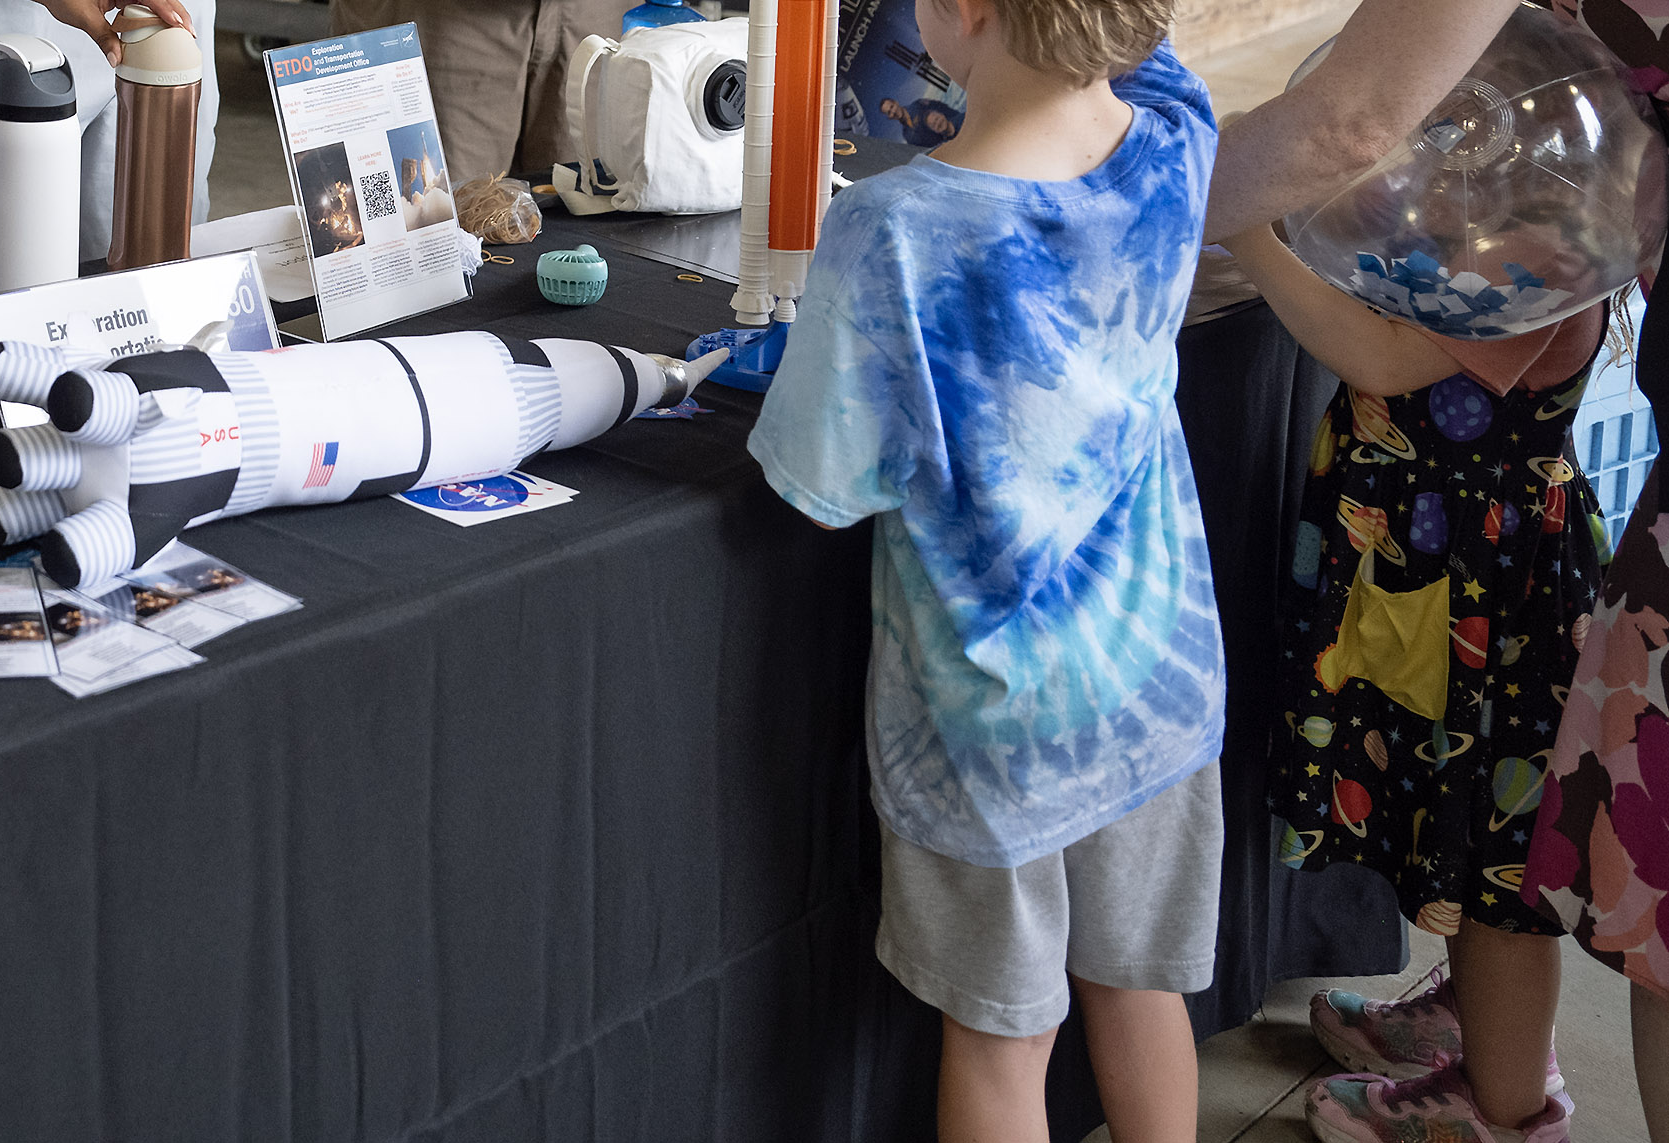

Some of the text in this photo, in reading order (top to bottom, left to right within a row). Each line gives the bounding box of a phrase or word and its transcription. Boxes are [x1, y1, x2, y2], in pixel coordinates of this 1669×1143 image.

[311, 43, 343, 56] Exploration
[841, 18, 872, 72] LAUNCH
[274, 56, 313, 78] ETDO
[313, 50, 365, 66] and Transportation
[315, 58, 370, 76] Development Office
[357, 154, 369, 162] LEARN
[45, 306, 149, 343] Exration
[200, 426, 239, 447] USA
